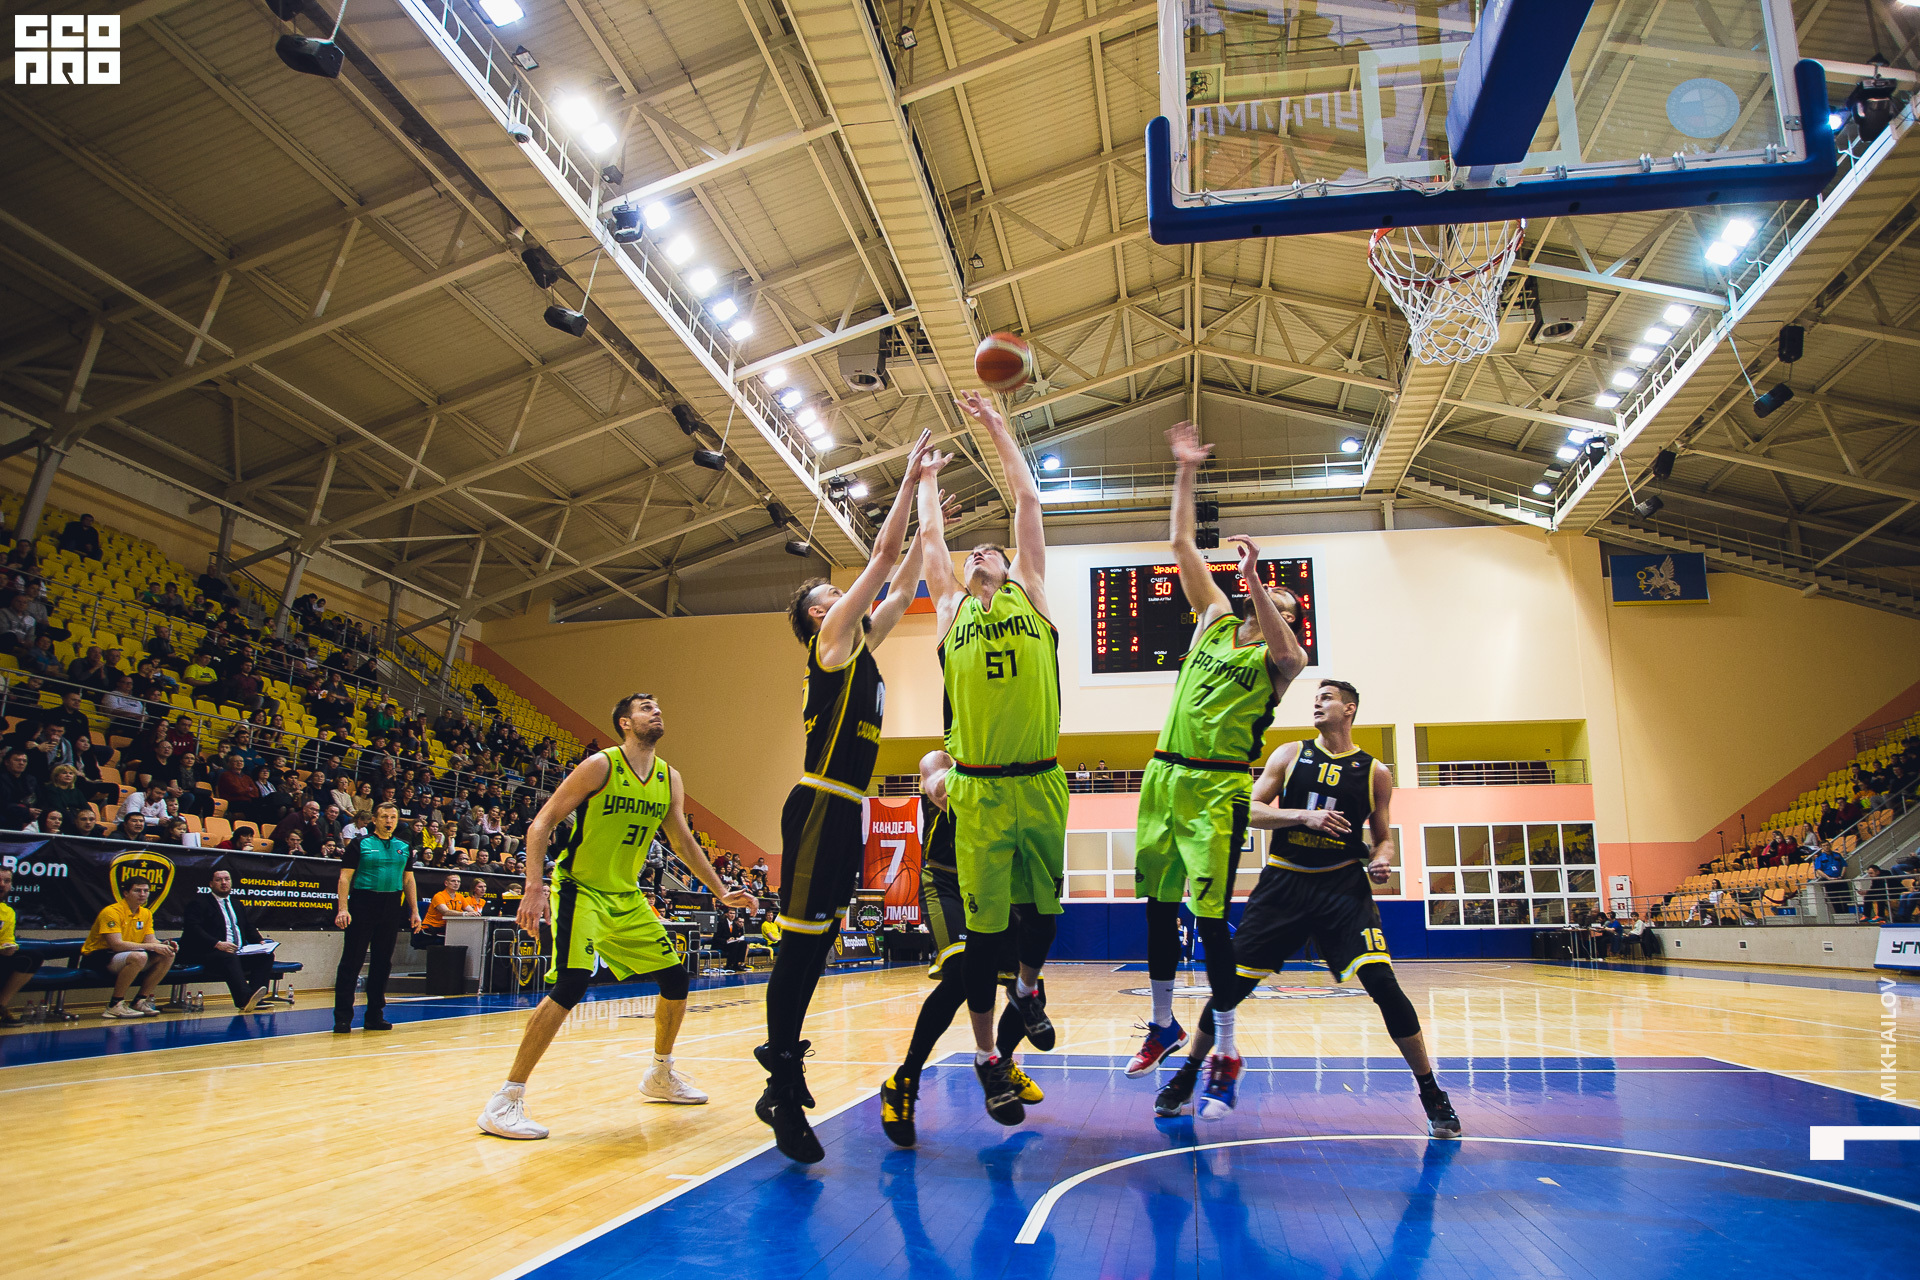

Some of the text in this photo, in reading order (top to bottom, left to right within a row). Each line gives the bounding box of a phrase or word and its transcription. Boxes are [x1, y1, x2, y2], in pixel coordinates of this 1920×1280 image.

[1155, 582, 1172, 595] 50
[985, 649, 1017, 680] 51
[1157, 655, 1165, 665] 2
[1195, 683, 1215, 706] 7
[1317, 763, 1342, 785] 15
[602, 794, 666, 819] УРАЛМА
[622, 824, 649, 847] 31
[872, 821, 915, 834] КАНДЕЛЬ
[0, 855, 68, 877] Boom
[880, 839, 906, 883] 7
[240, 878, 319, 889] ФИНАЛЬНЫЙ ЭТАП
[247, 889, 285, 897] РОССИИ
[1197, 877, 1214, 901] 7
[254, 899, 297, 908] МУЖСКИХ
[299, 901, 333, 910] КОМАНД
[884, 905, 918, 921] ЛМАШ
[1361, 928, 1387, 951] 15
